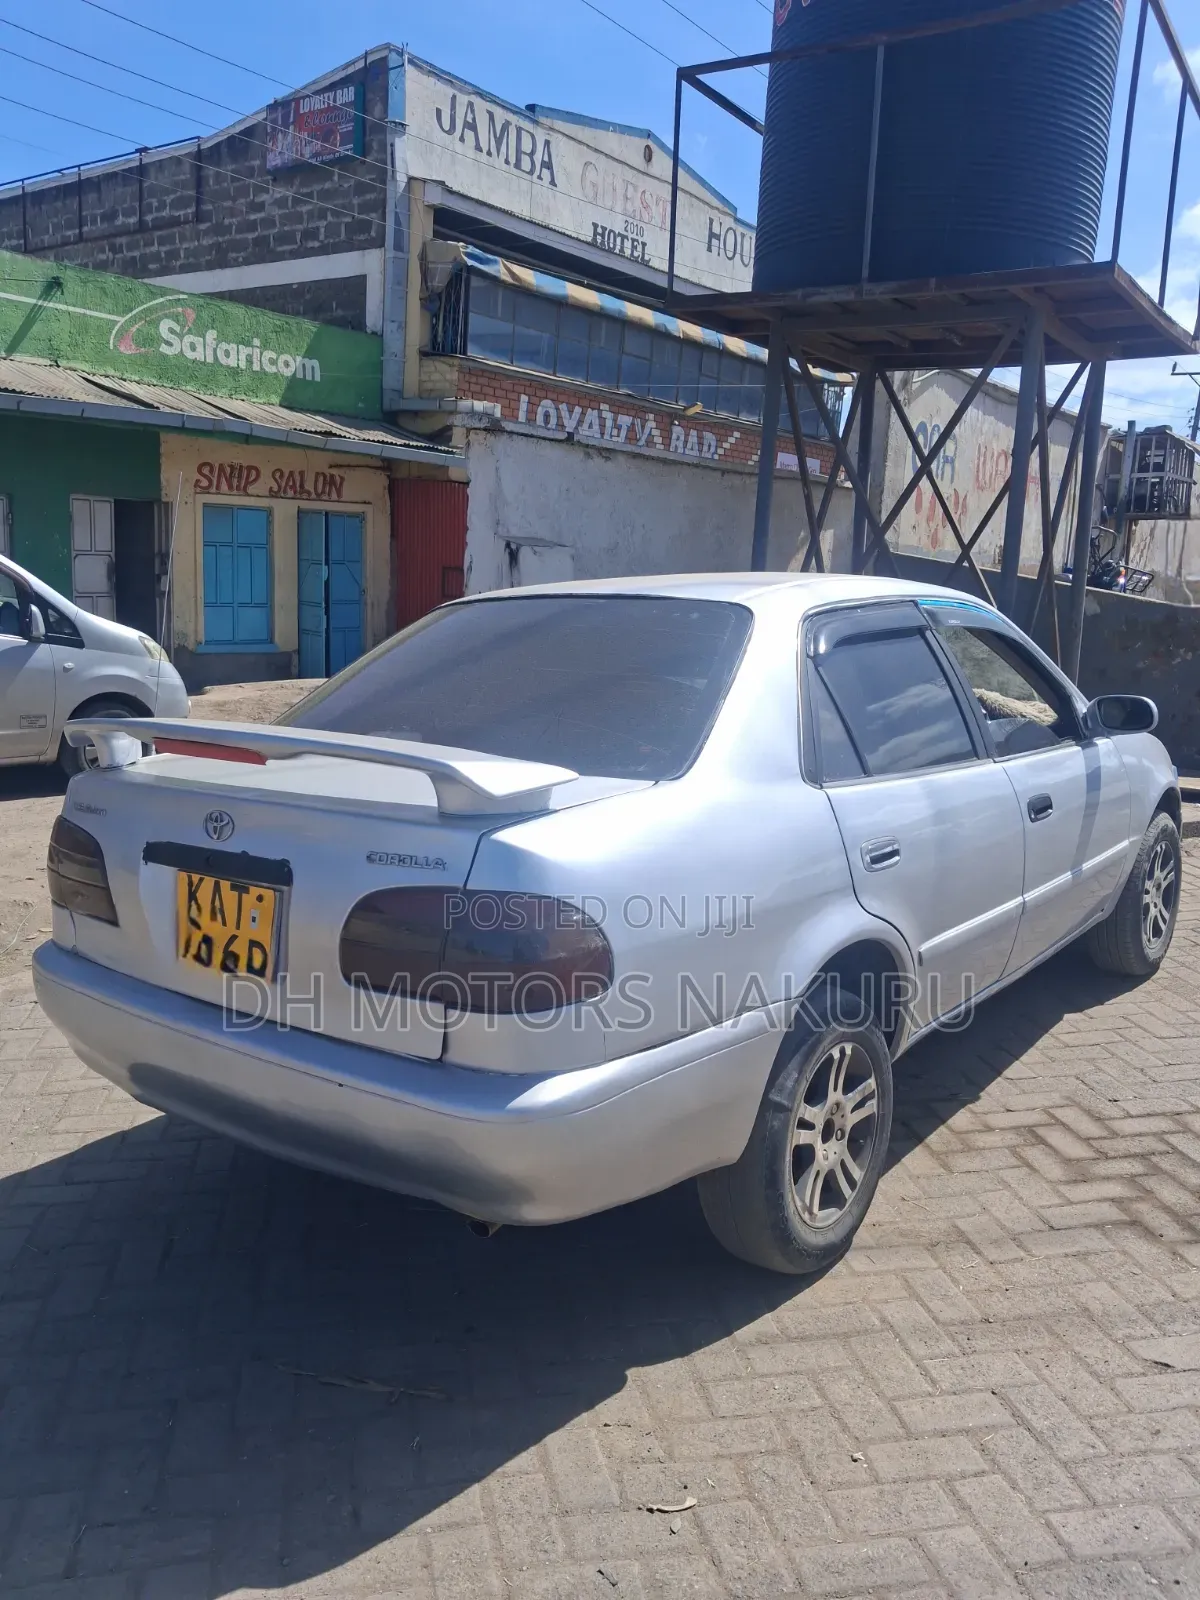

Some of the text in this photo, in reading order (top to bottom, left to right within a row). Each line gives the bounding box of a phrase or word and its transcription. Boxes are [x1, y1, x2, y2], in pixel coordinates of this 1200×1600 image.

[300, 87, 354, 113] LOYALTY BAR
[435, 93, 753, 268] JAMBA GUEST HOU
[591, 221, 652, 265] HOTEL
[624, 219, 645, 238] 2010
[159, 318, 321, 382] Safaricom
[269, 468, 346, 500] SALON
[366, 850, 448, 872] COROLLA
[186, 873, 251, 931] KAT
